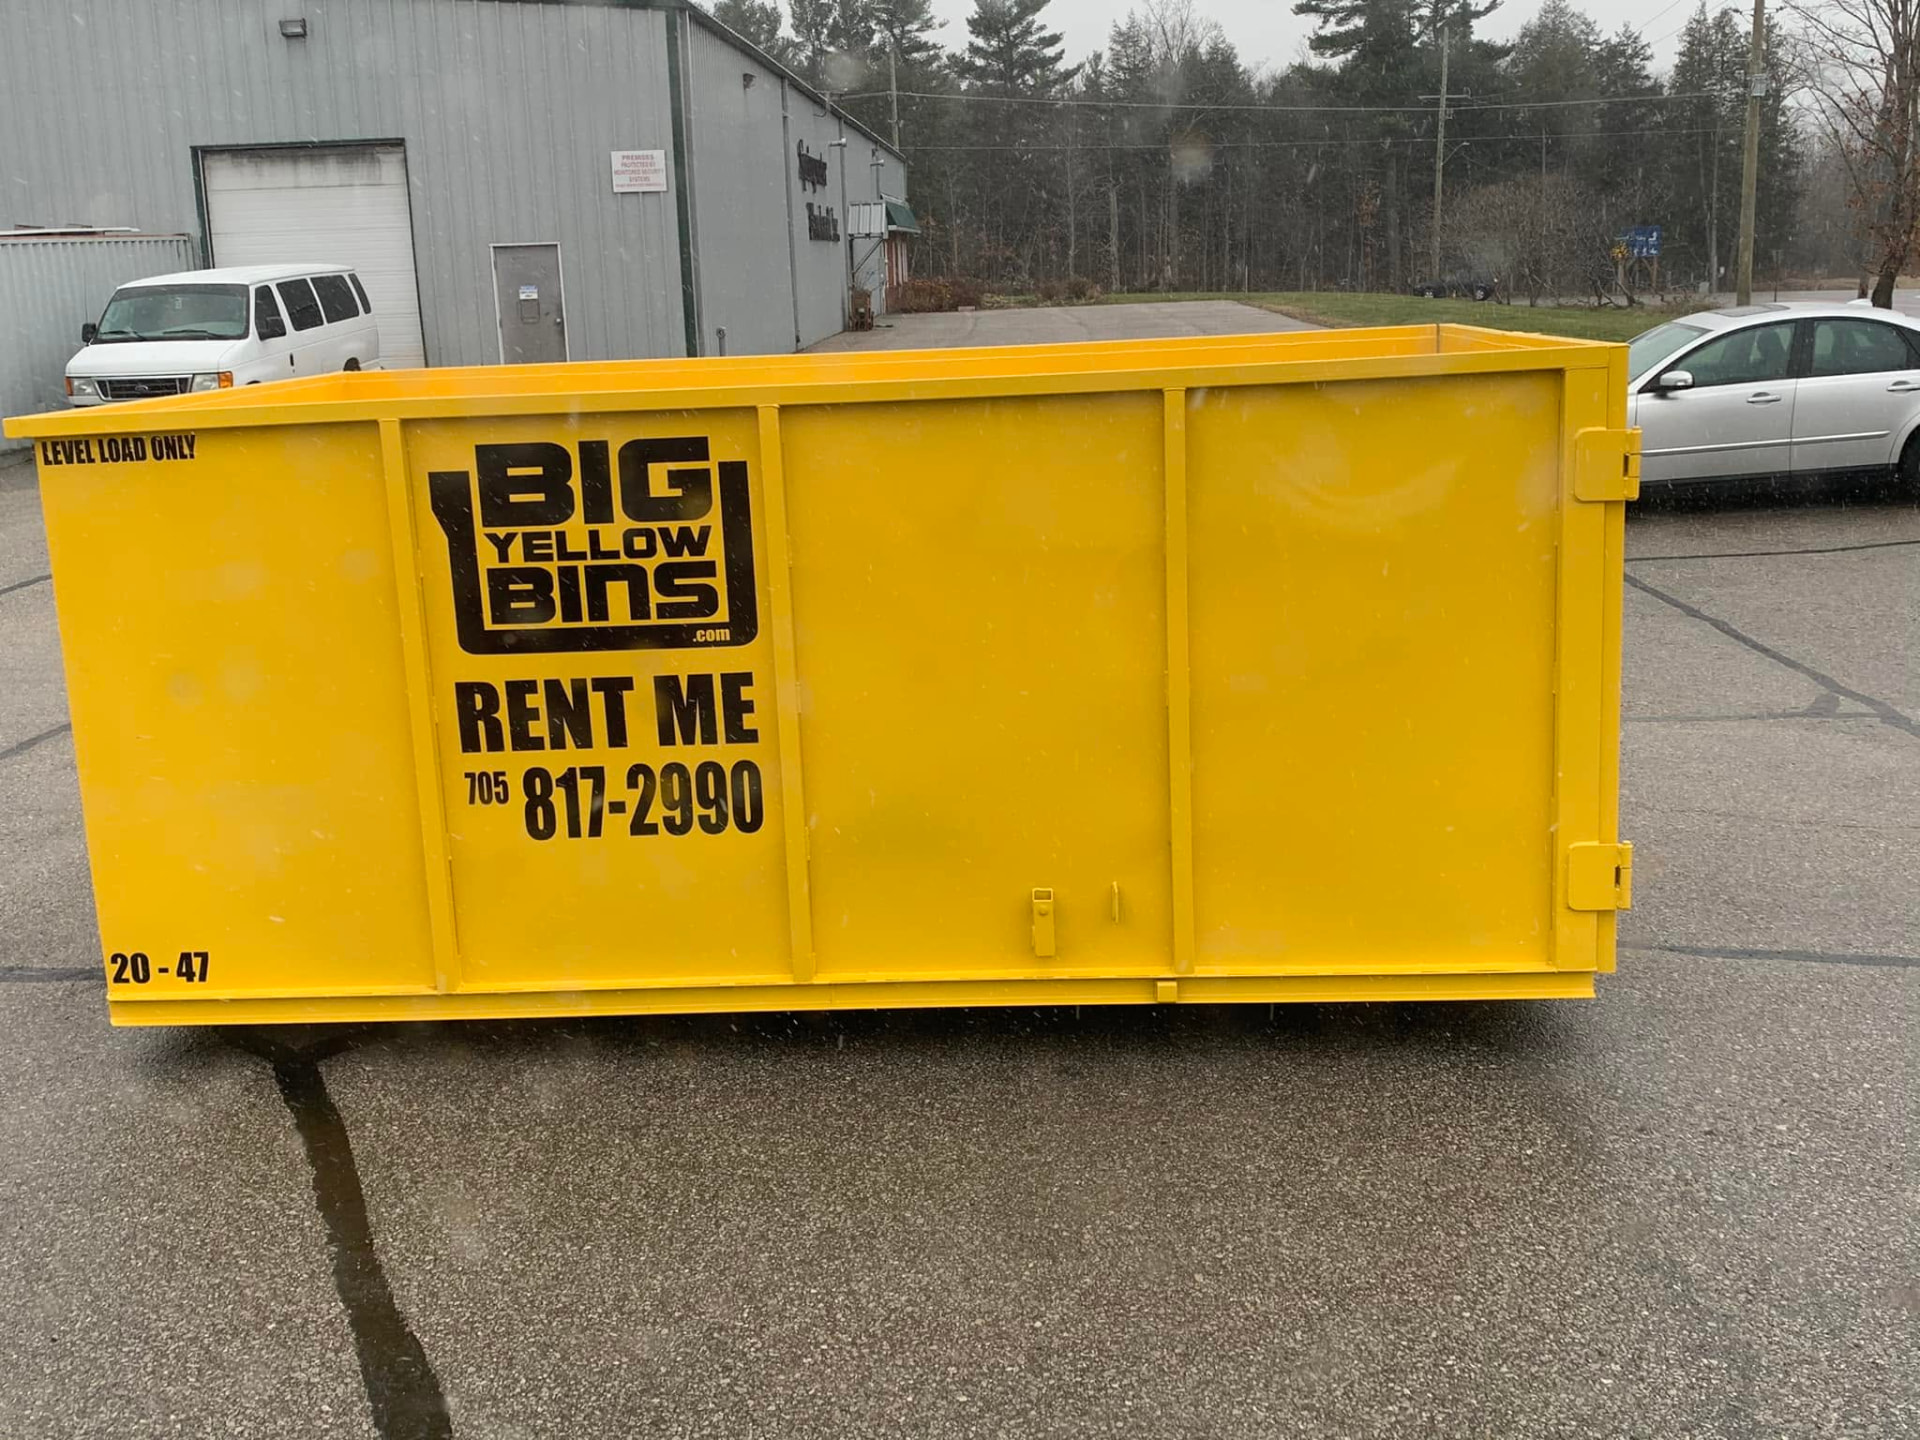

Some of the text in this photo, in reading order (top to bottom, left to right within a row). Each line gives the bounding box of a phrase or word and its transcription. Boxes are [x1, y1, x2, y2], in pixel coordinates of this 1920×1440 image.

[41, 434, 196, 466] LEVEL LOAD ONLY
[474, 436, 713, 528] BIG
[484, 525, 712, 563] YELLOW
[692, 627, 730, 643] .com
[454, 671, 759, 753] RENT ME
[464, 759, 764, 841] 705 817-2990
